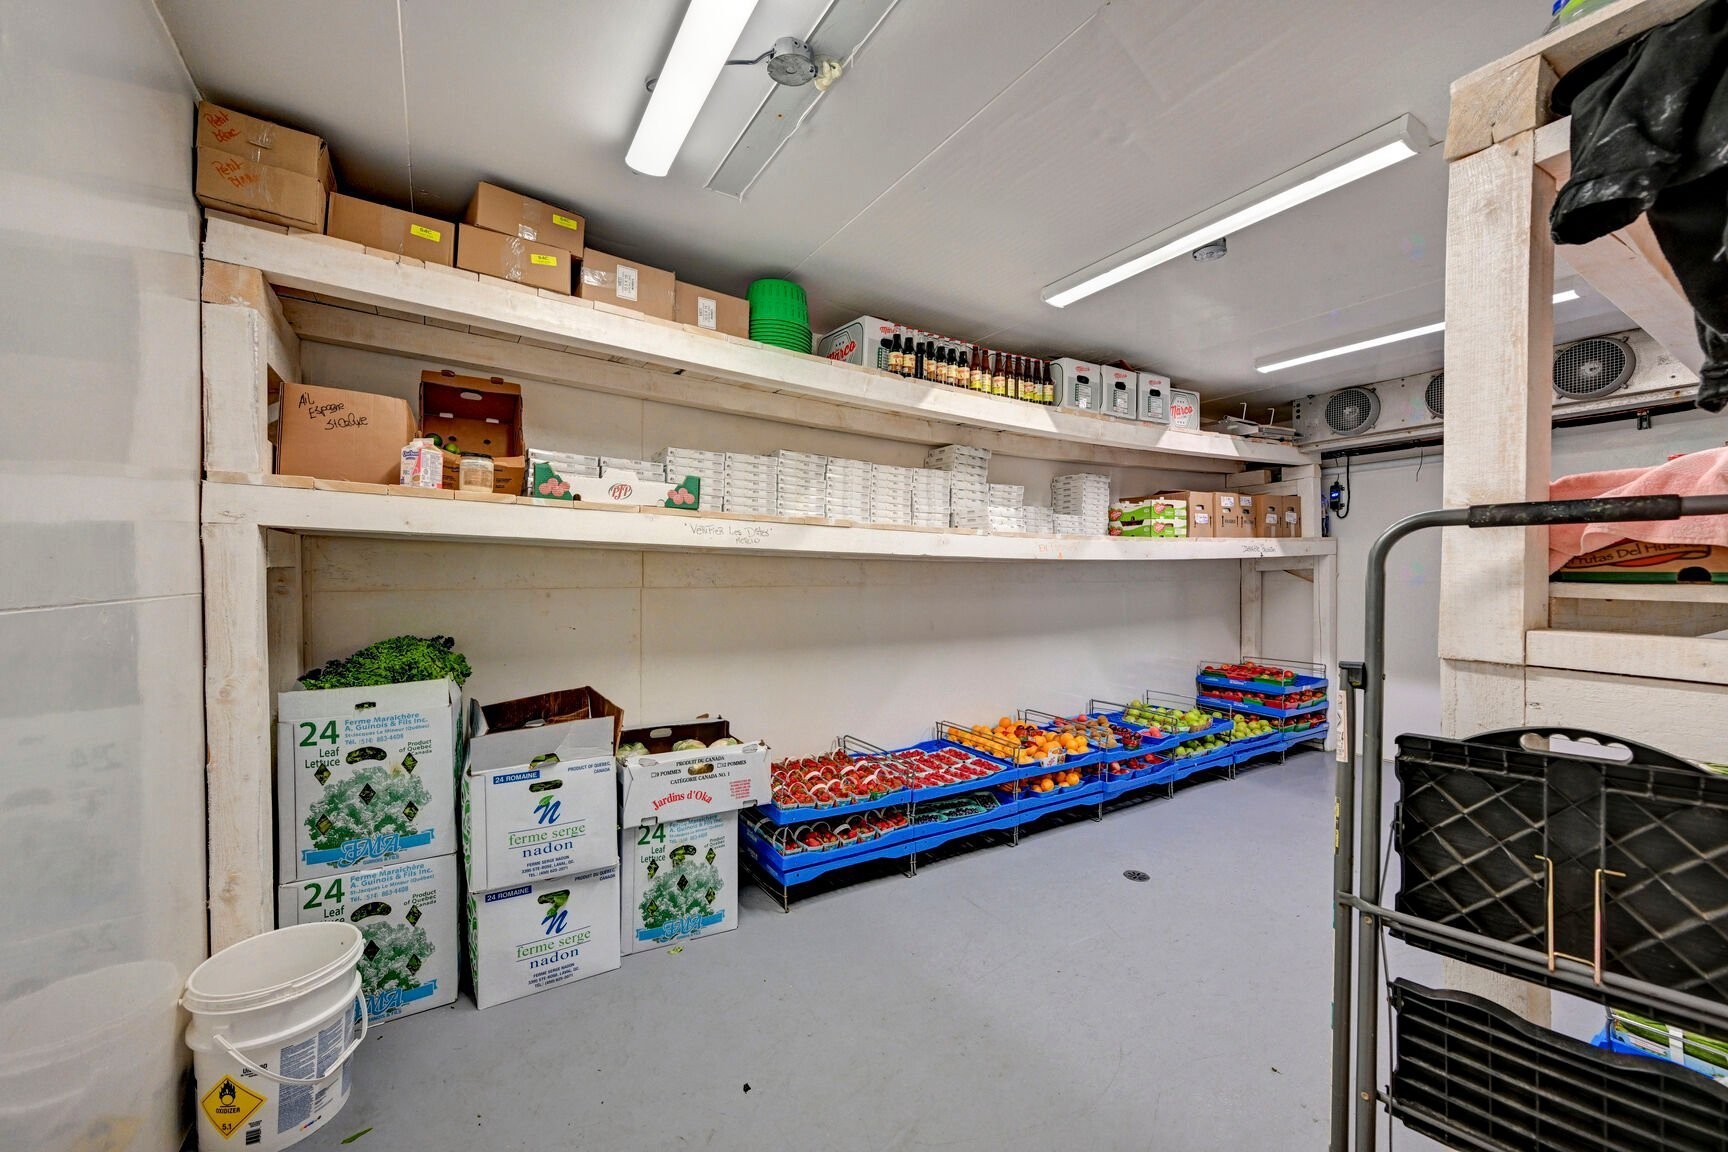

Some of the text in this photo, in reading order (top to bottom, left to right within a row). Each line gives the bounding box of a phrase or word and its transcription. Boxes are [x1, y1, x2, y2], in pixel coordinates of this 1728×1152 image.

[1617, 543, 1641, 558] Del
[344, 718, 372, 726] Ferme
[299, 720, 340, 747] 24
[319, 746, 340, 758] Leaf
[304, 758, 340, 769] Lettuce
[675, 759, 697, 767] PRODUIT
[494, 772, 538, 784] 24 ROMAINE
[660, 769, 682, 777] POMMES
[652, 790, 713, 811] Jardins d'Oka
[508, 824, 586, 846] ferme serge
[637, 823, 666, 846] 24
[522, 840, 574, 858] nadon
[651, 845, 666, 854] Leaf
[640, 854, 666, 864] Lettuce
[350, 872, 377, 882] Ferme
[361, 876, 393, 886] Guinois
[403, 870, 417, 878] Fils
[418, 867, 433, 875] Inc.
[303, 878, 345, 910] 24
[412, 889, 437, 899] Product
[486, 887, 530, 902] 24 ROMAINE
[323, 905, 345, 918] Leaf
[516, 930, 591, 959] ferme serge
[529, 948, 579, 969] nadon
[222, 1123, 232, 1131] 5.1
